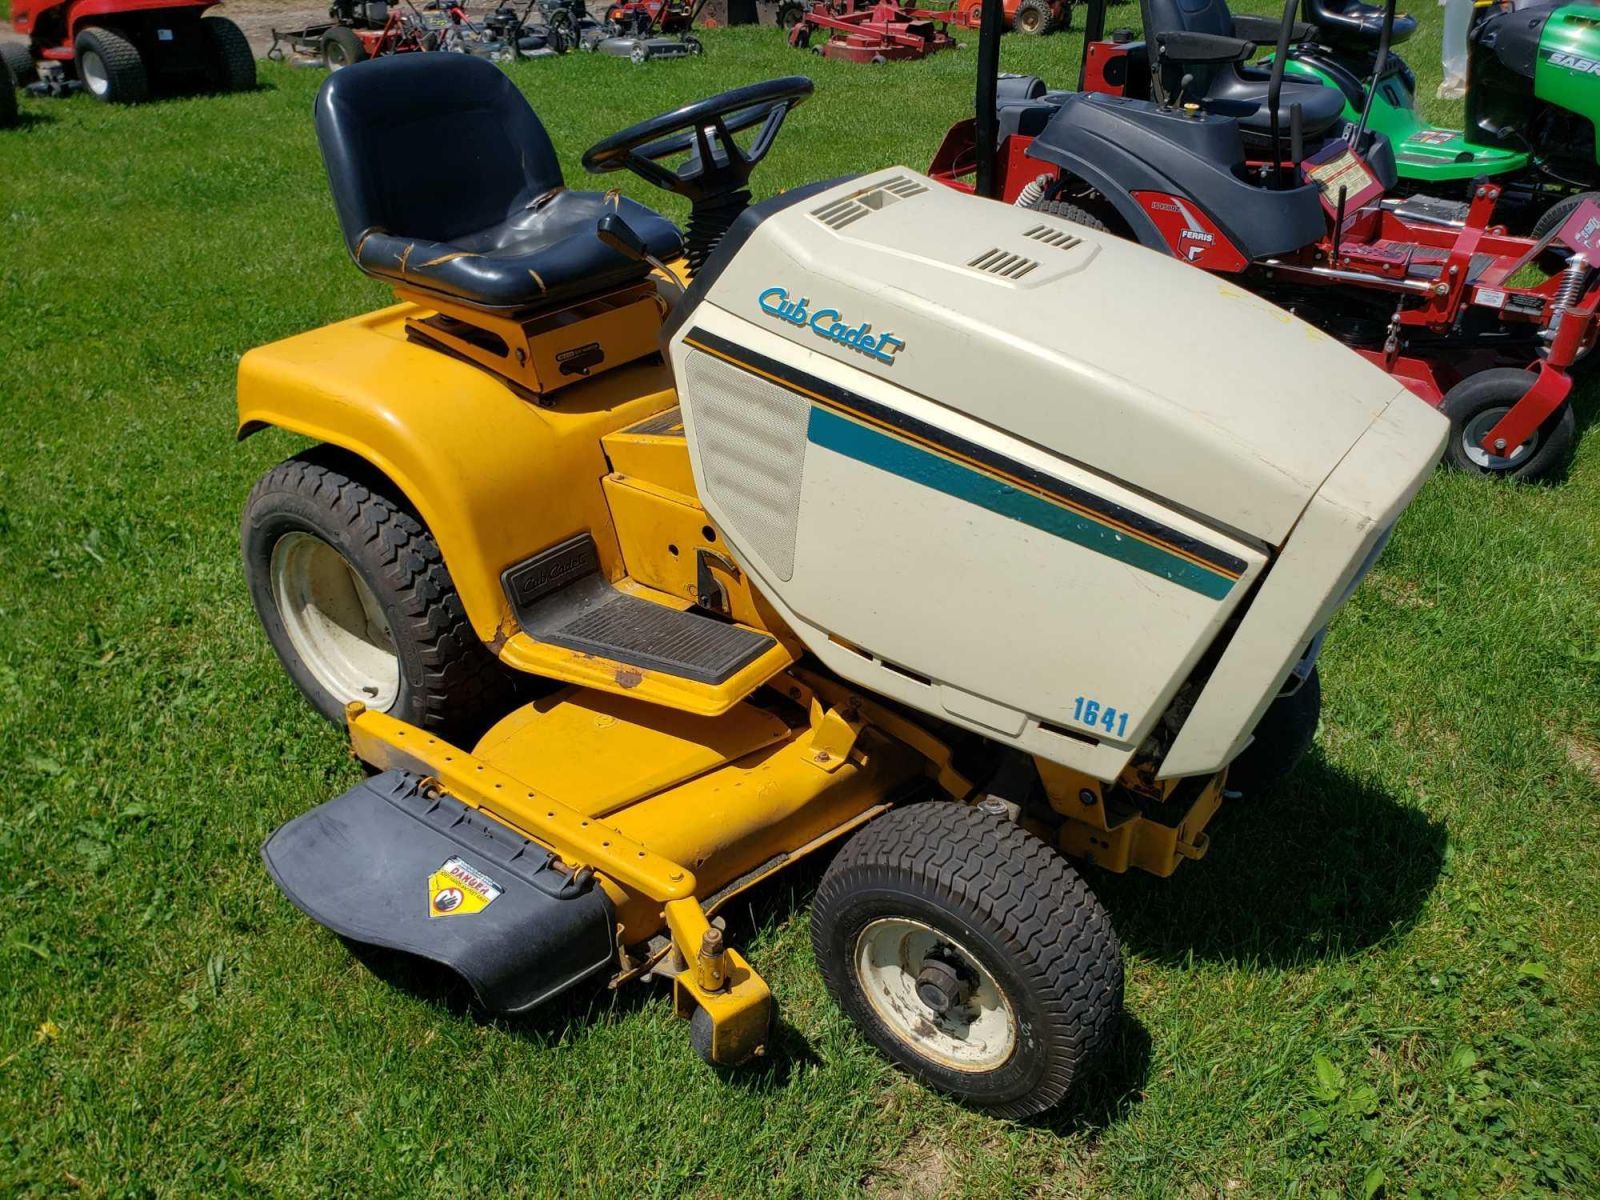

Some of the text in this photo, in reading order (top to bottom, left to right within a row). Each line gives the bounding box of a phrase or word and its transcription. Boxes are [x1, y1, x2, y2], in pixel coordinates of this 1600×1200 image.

[1182, 230, 1213, 242] FERRIS
[758, 286, 905, 366] Cub Cadet
[523, 554, 587, 593] Cub Cadet
[1074, 696, 1129, 737] 1641
[450, 866, 490, 895] DANGER
